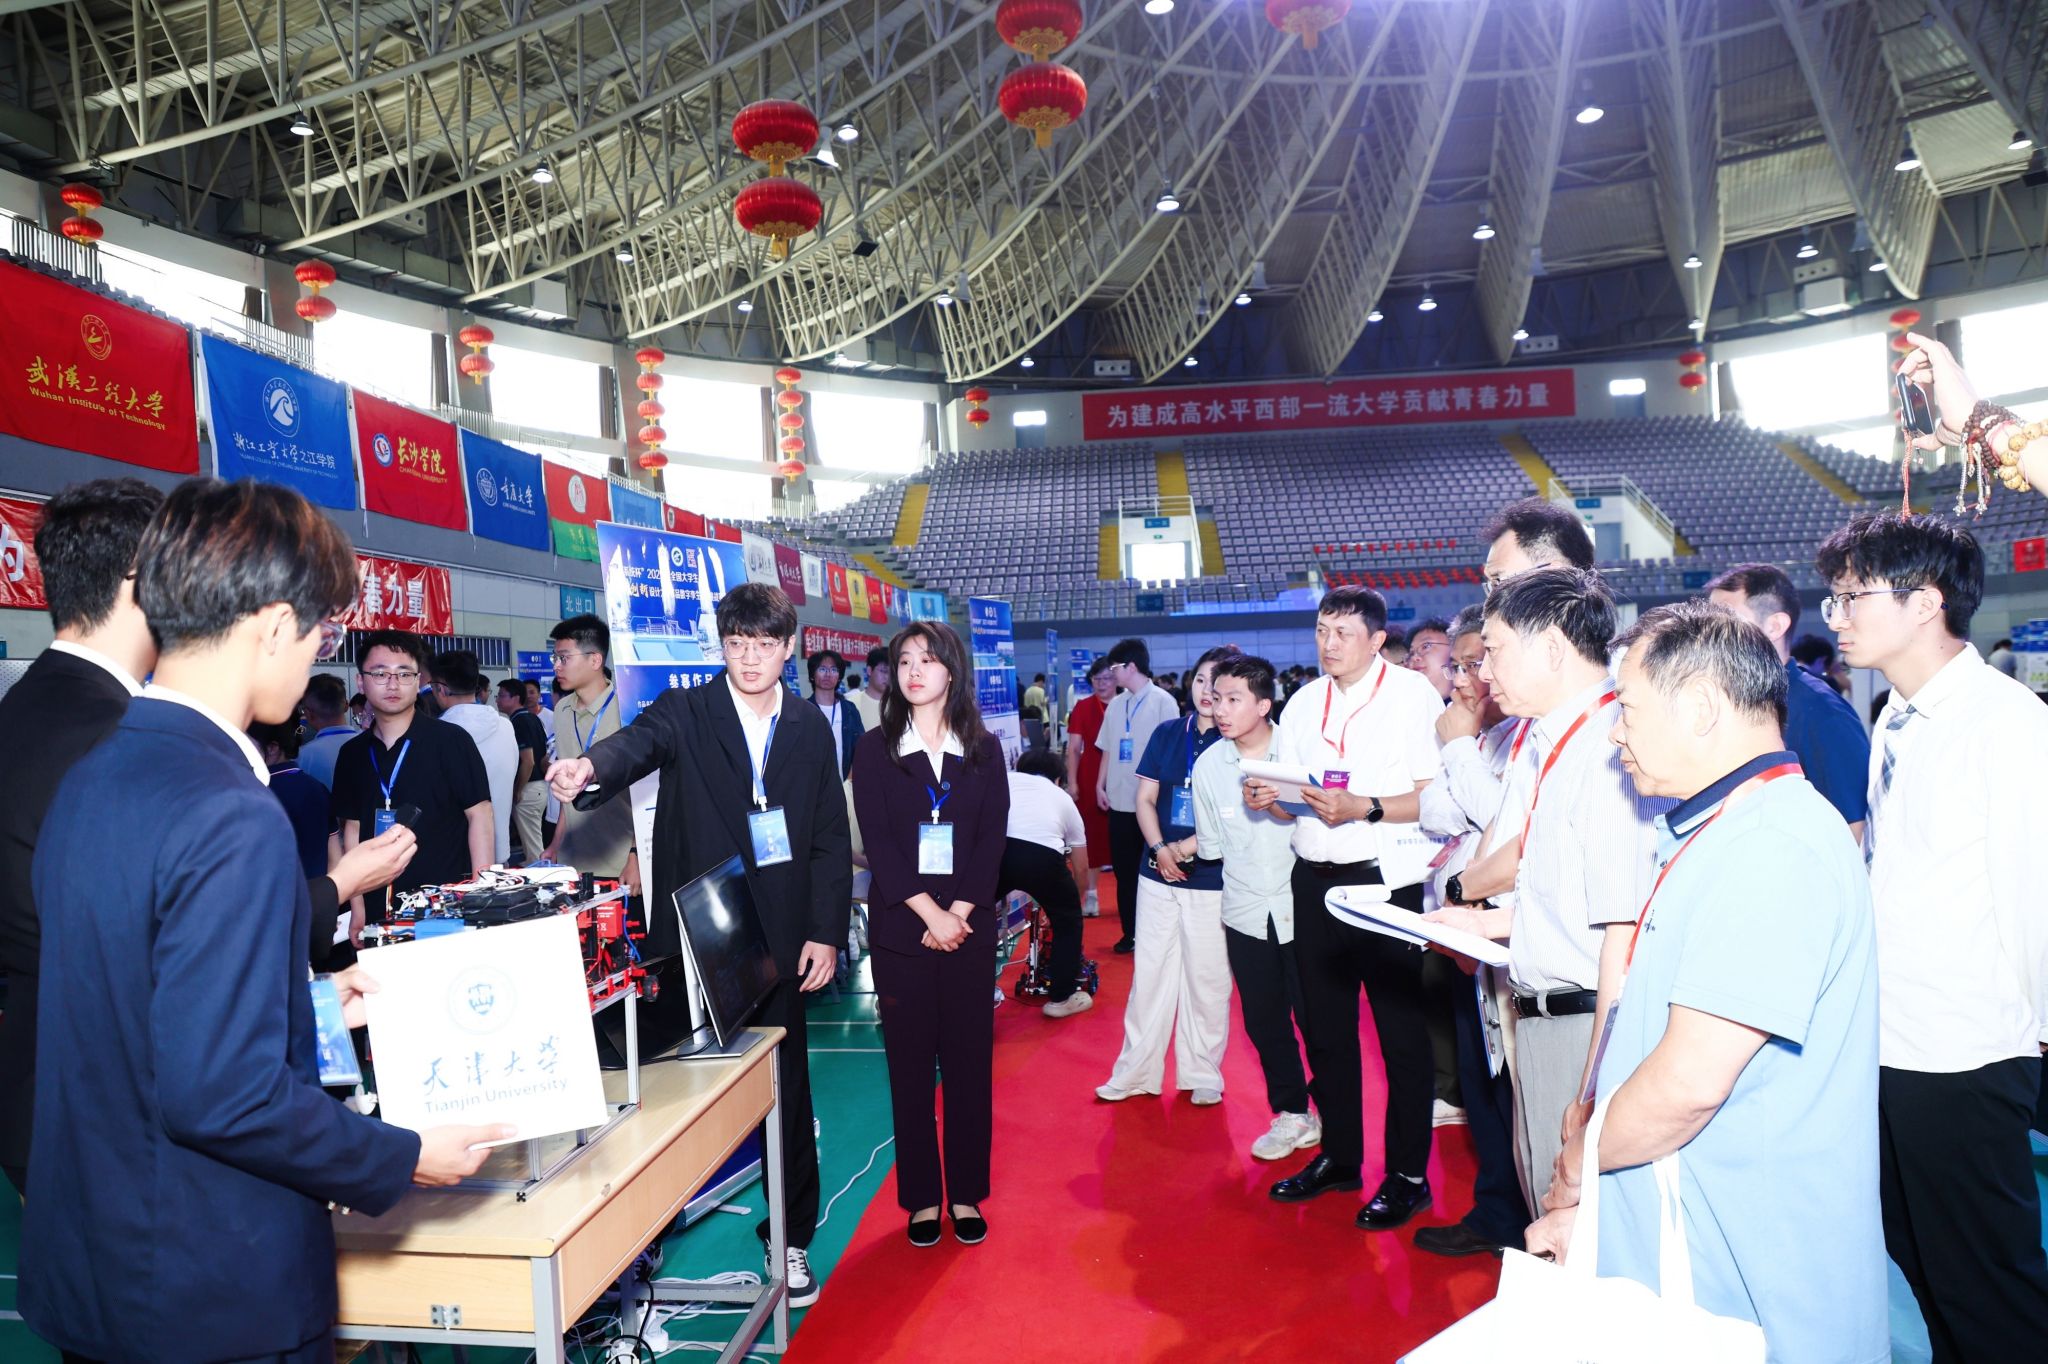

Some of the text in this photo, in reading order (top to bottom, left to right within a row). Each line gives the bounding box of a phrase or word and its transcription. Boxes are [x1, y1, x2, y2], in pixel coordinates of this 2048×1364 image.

[29, 385, 166, 431] Wuhan Institute of Technology
[1107, 383, 1549, 428] 为建成高水平西部一流大学贡献青春力量
[565, 595, 592, 613] 北出口
[423, 1035, 560, 1096] 天津大学
[424, 1078, 568, 1113] Tianjin University
